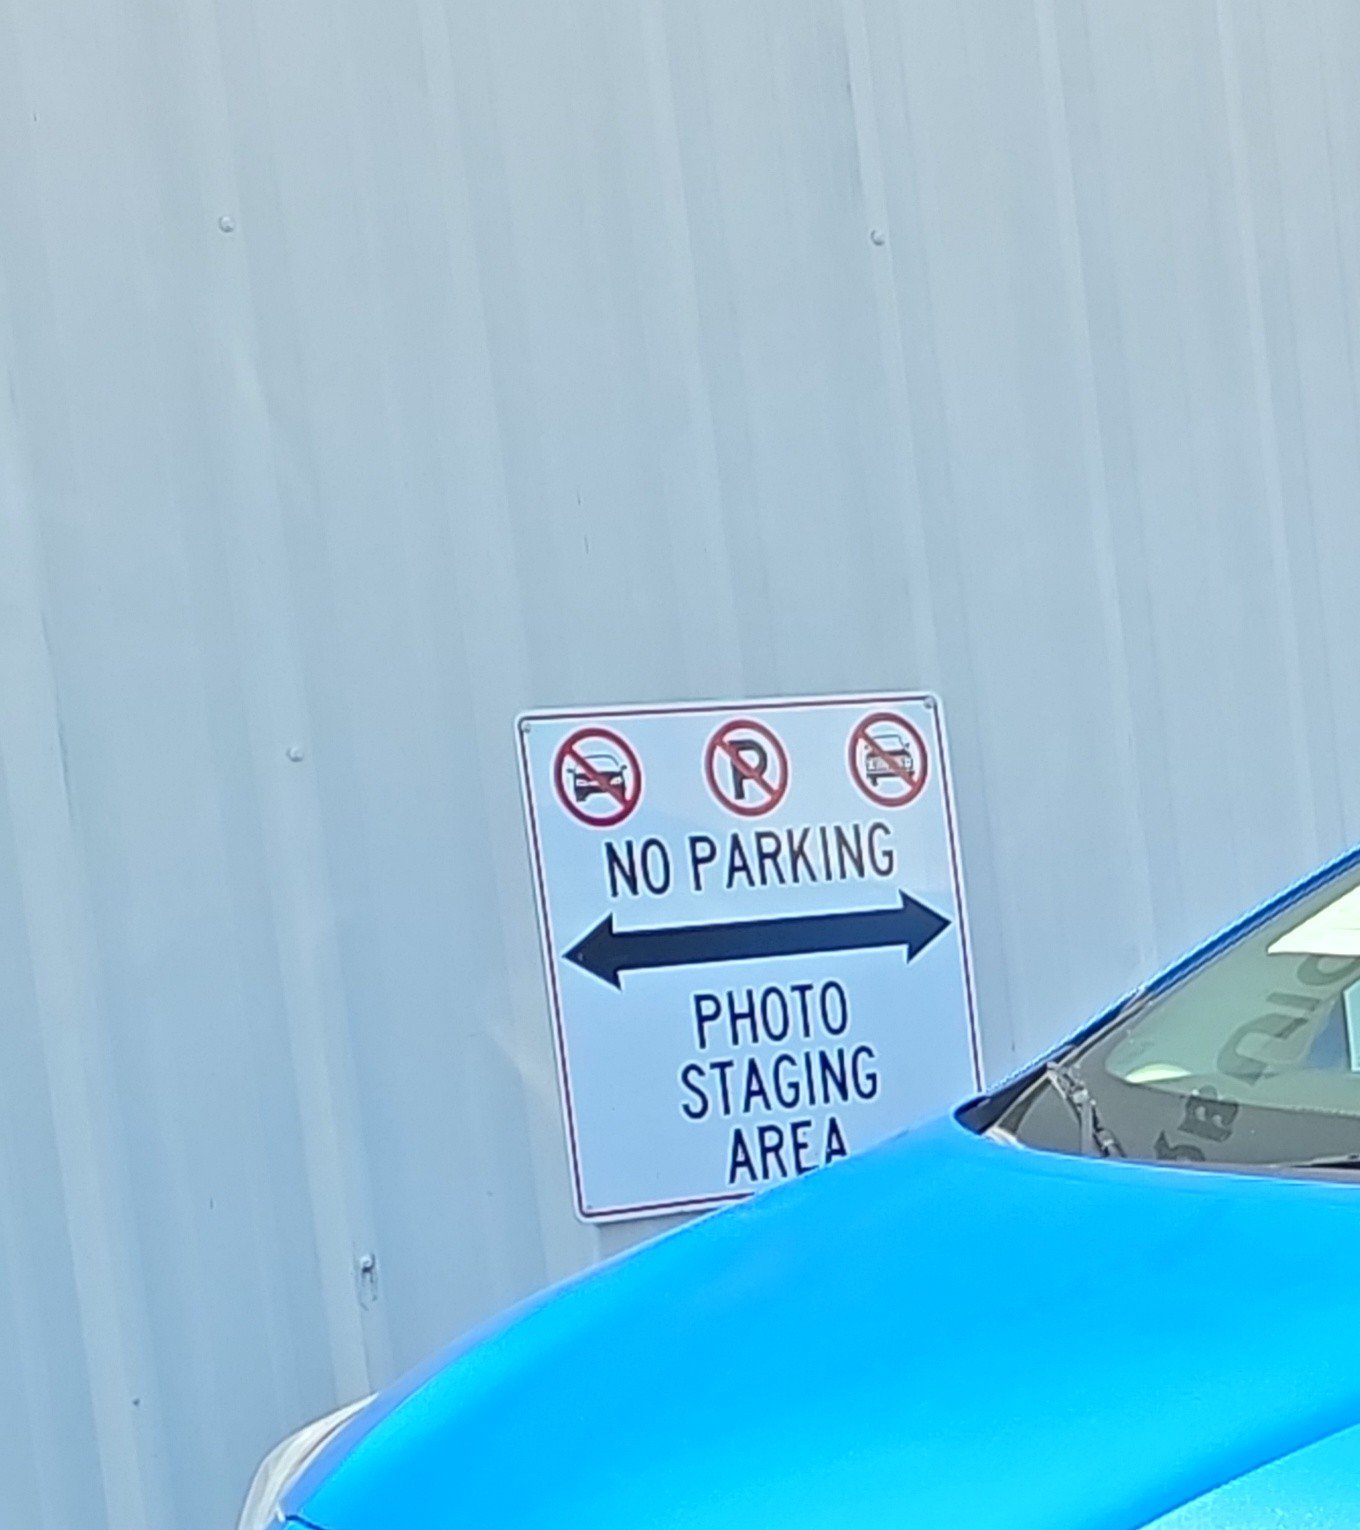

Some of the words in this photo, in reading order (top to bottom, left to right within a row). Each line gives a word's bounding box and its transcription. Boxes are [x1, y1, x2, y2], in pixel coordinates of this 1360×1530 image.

[604, 838, 672, 898] NO
[689, 822, 895, 892] PARKING
[693, 979, 849, 1050] PHOTO
[681, 1044, 878, 1119] STAGING
[727, 1116, 849, 1185] AREA
